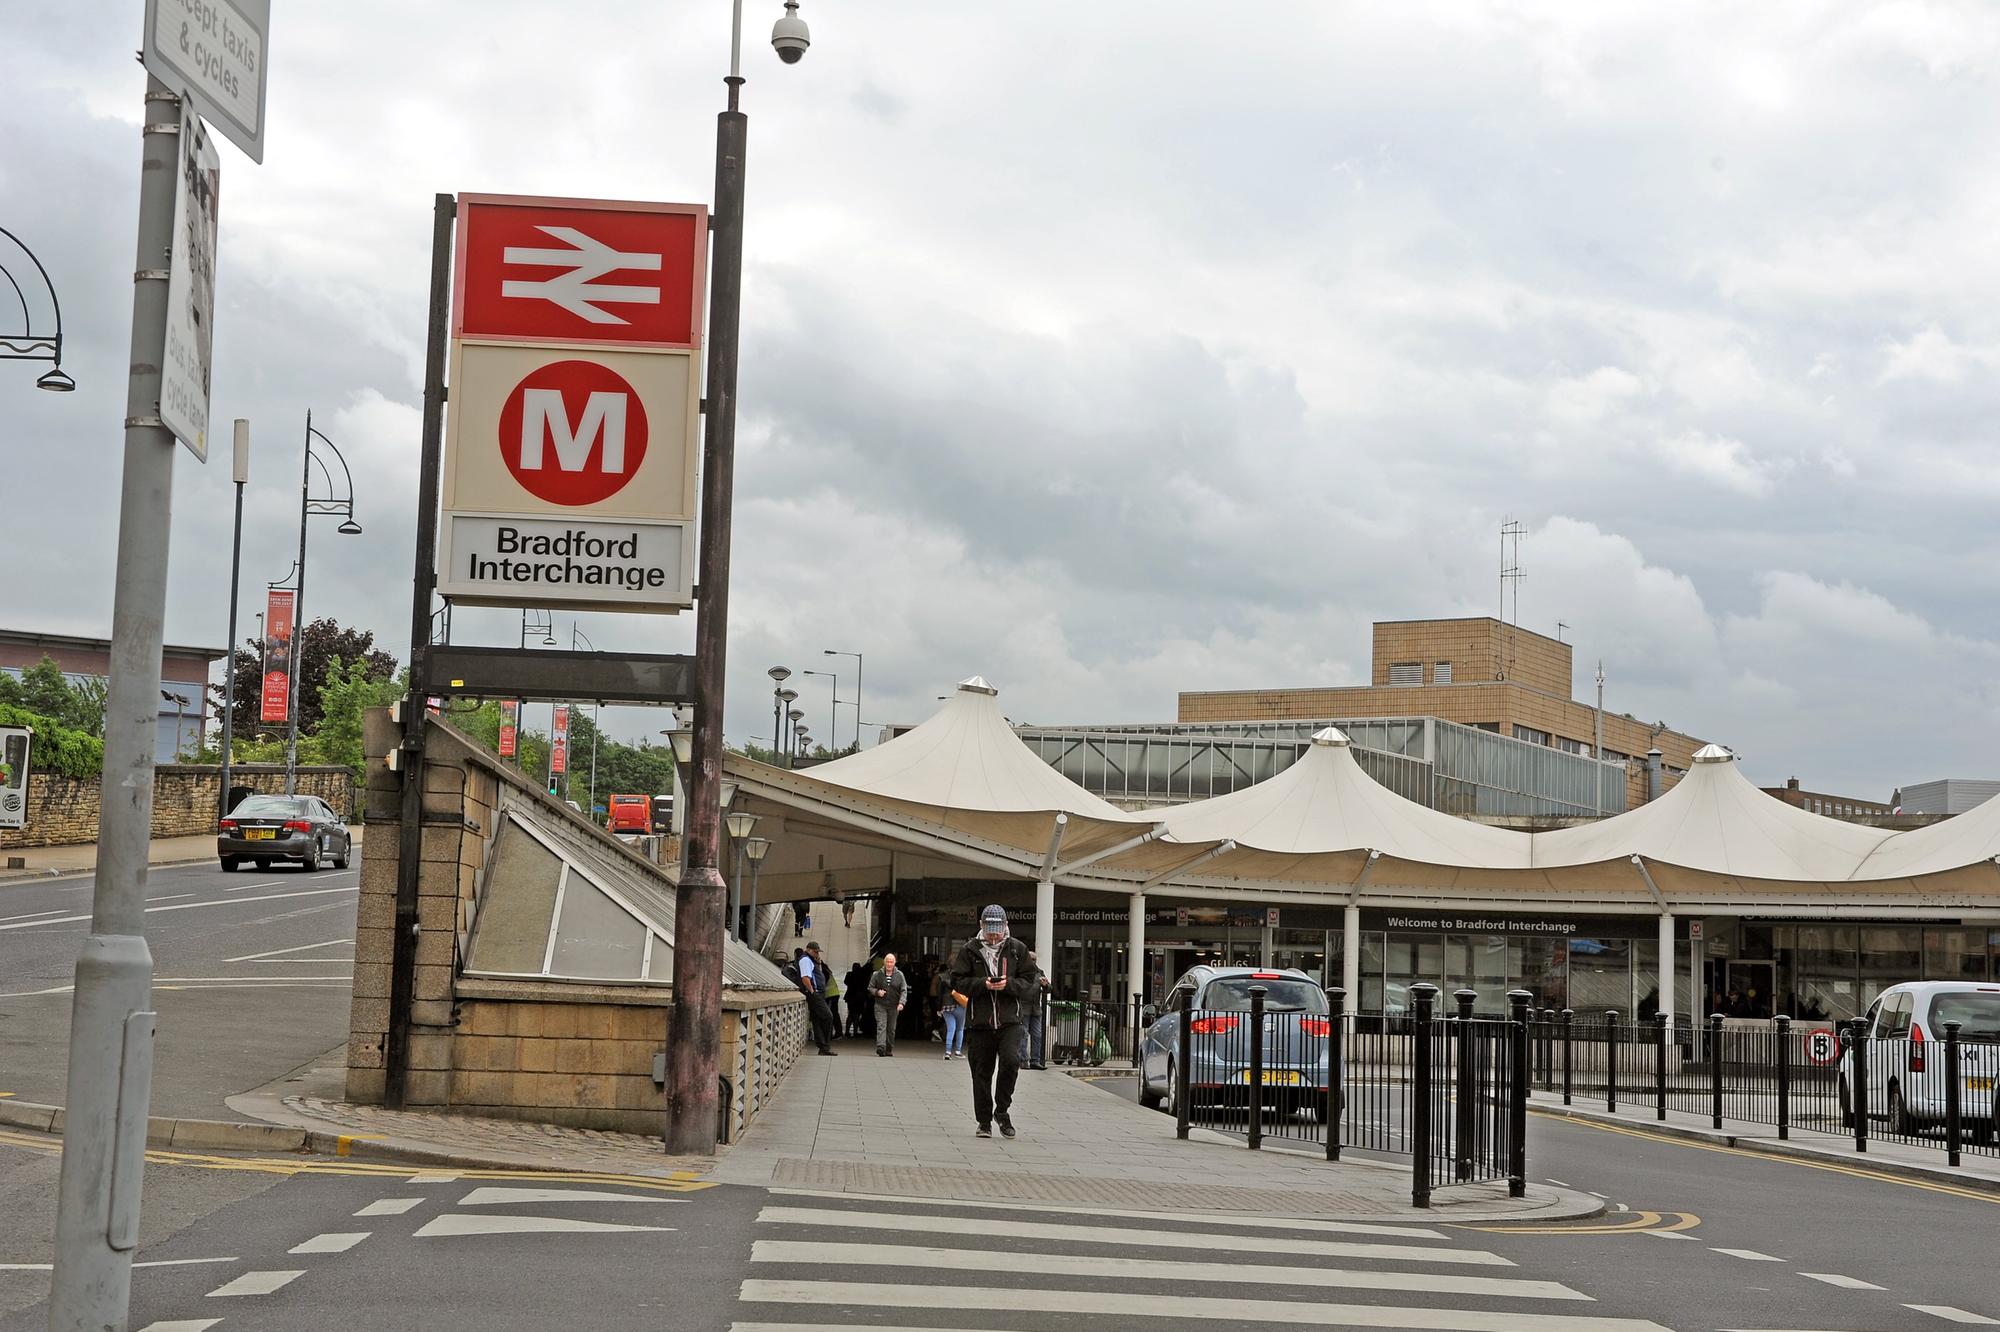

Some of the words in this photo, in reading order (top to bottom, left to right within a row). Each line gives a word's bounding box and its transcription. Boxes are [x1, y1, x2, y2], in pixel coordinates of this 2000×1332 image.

[176, 0, 218, 37] cept
[222, 17, 255, 73] taxis
[179, 22, 190, 55] &
[195, 42, 239, 99] cycles
[166, 377, 188, 418] cycle
[188, 392, 206, 430] lane
[519, 388, 628, 474] M
[497, 527, 638, 559] Bradford
[469, 553, 665, 591] Interchange
[1060, 910, 1099, 921] Bradford
[1102, 911, 1157, 924] Intercge
[1387, 916, 1438, 928] Welcome
[1440, 919, 1453, 929] to
[1456, 919, 1506, 930] Bradford
[1508, 920, 1577, 934] Interchange
